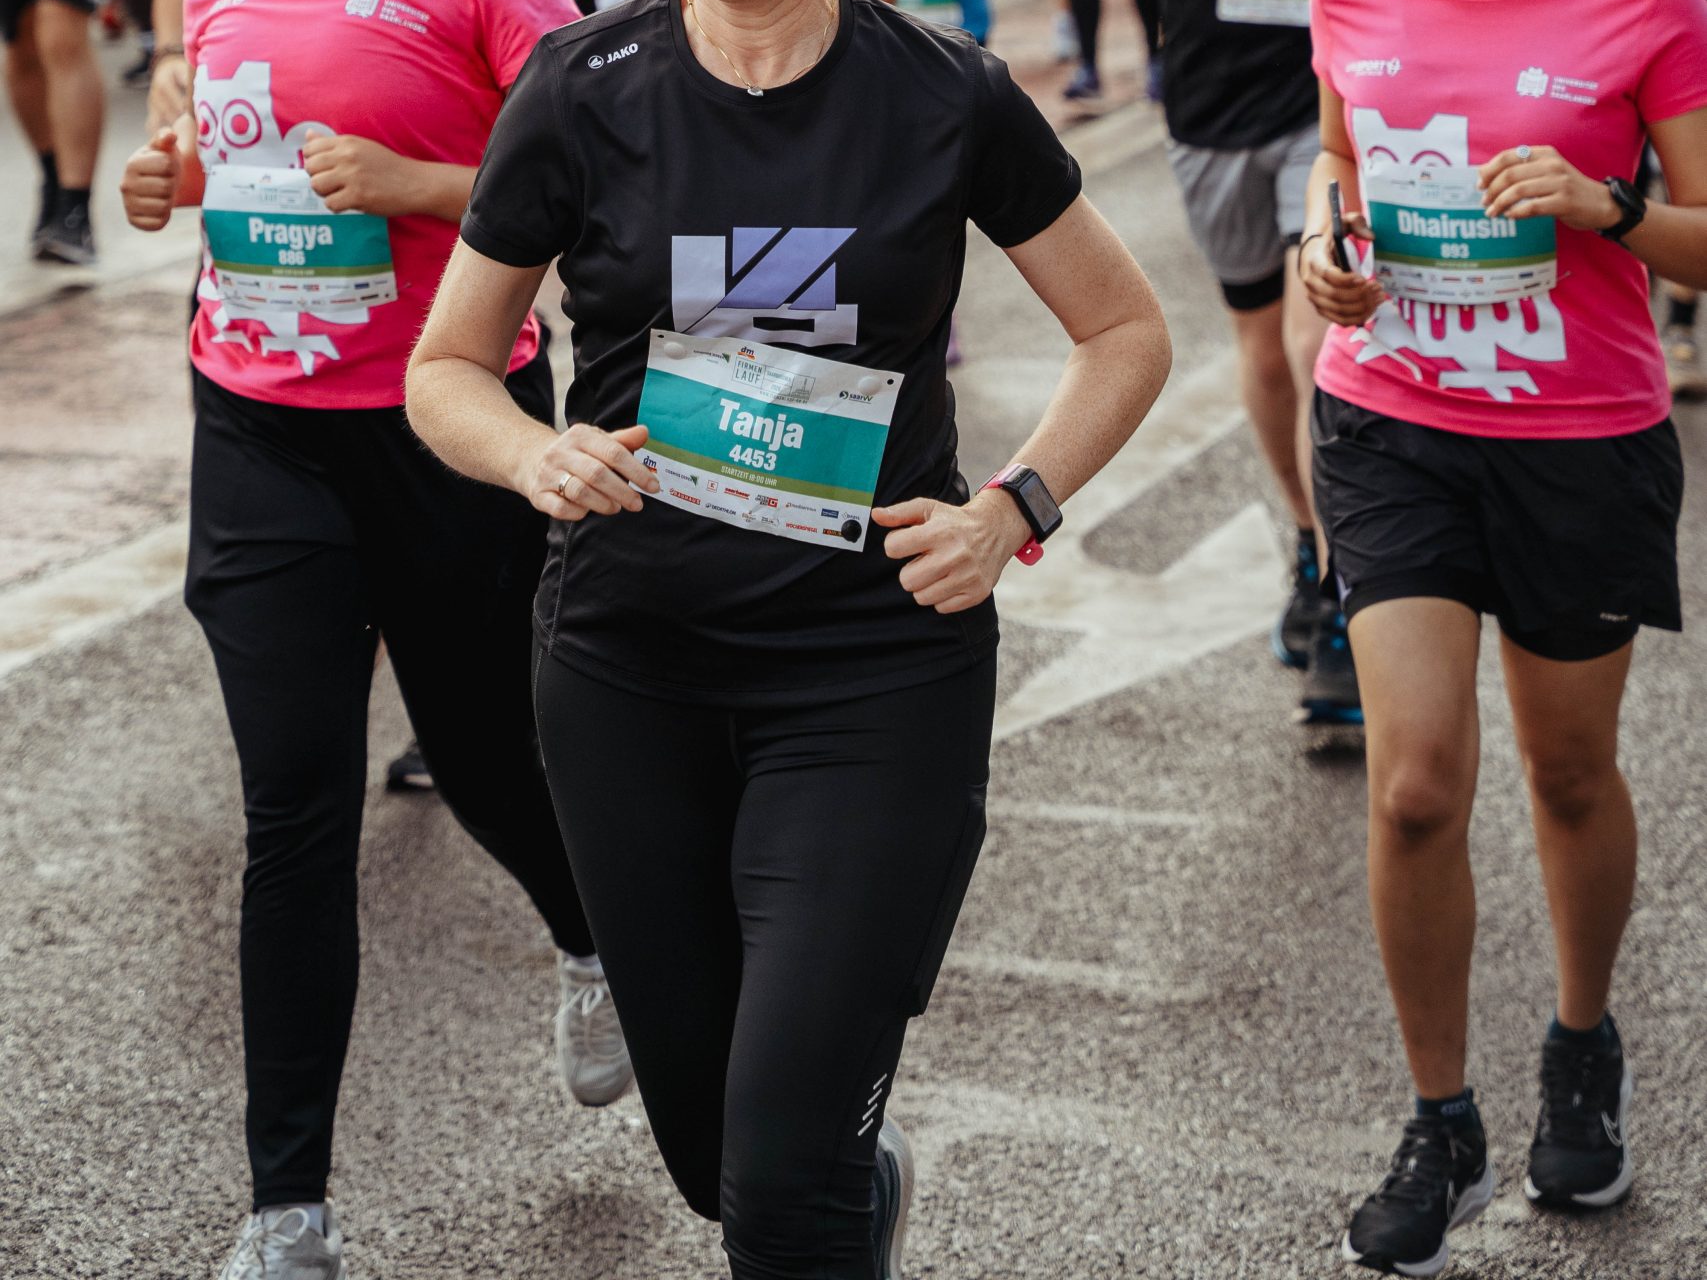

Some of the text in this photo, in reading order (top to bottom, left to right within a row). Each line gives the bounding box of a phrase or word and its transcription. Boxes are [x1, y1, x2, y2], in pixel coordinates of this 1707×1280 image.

[607, 43, 639, 64] JAKO
[1396, 208, 1517, 239] Dhairushi
[248, 216, 334, 251] Pragya
[1440, 242, 1470, 259] 893
[740, 346, 755, 356] dm
[737, 360, 763, 373] FIRMEN
[735, 369, 761, 384] LAUF
[718, 397, 804, 452] Tanja
[643, 455, 657, 468] dm
[728, 444, 777, 471] 4453
[721, 465, 749, 480] STARTZEIT
[765, 477, 778, 487] UHR
[674, 491, 701, 505] BAUHAUS
[711, 505, 737, 516] DECATHLON
